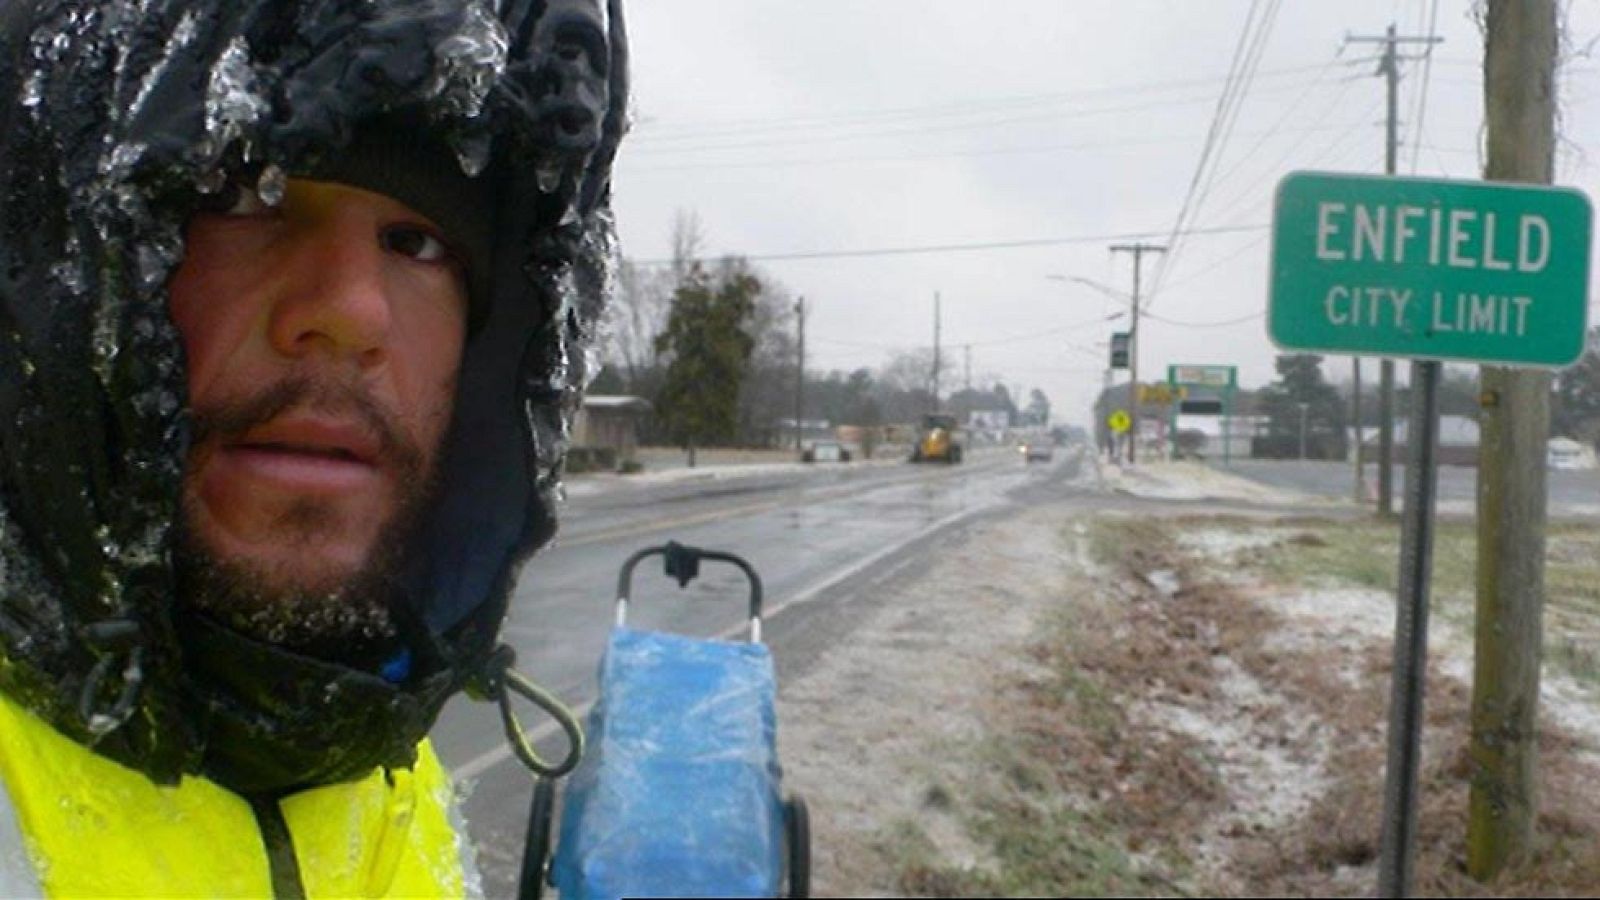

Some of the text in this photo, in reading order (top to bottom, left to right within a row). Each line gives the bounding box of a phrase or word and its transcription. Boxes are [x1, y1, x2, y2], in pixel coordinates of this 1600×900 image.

[1316, 202, 1551, 273] ENFIELD
[1325, 286, 1532, 336] CITY LIMIT
